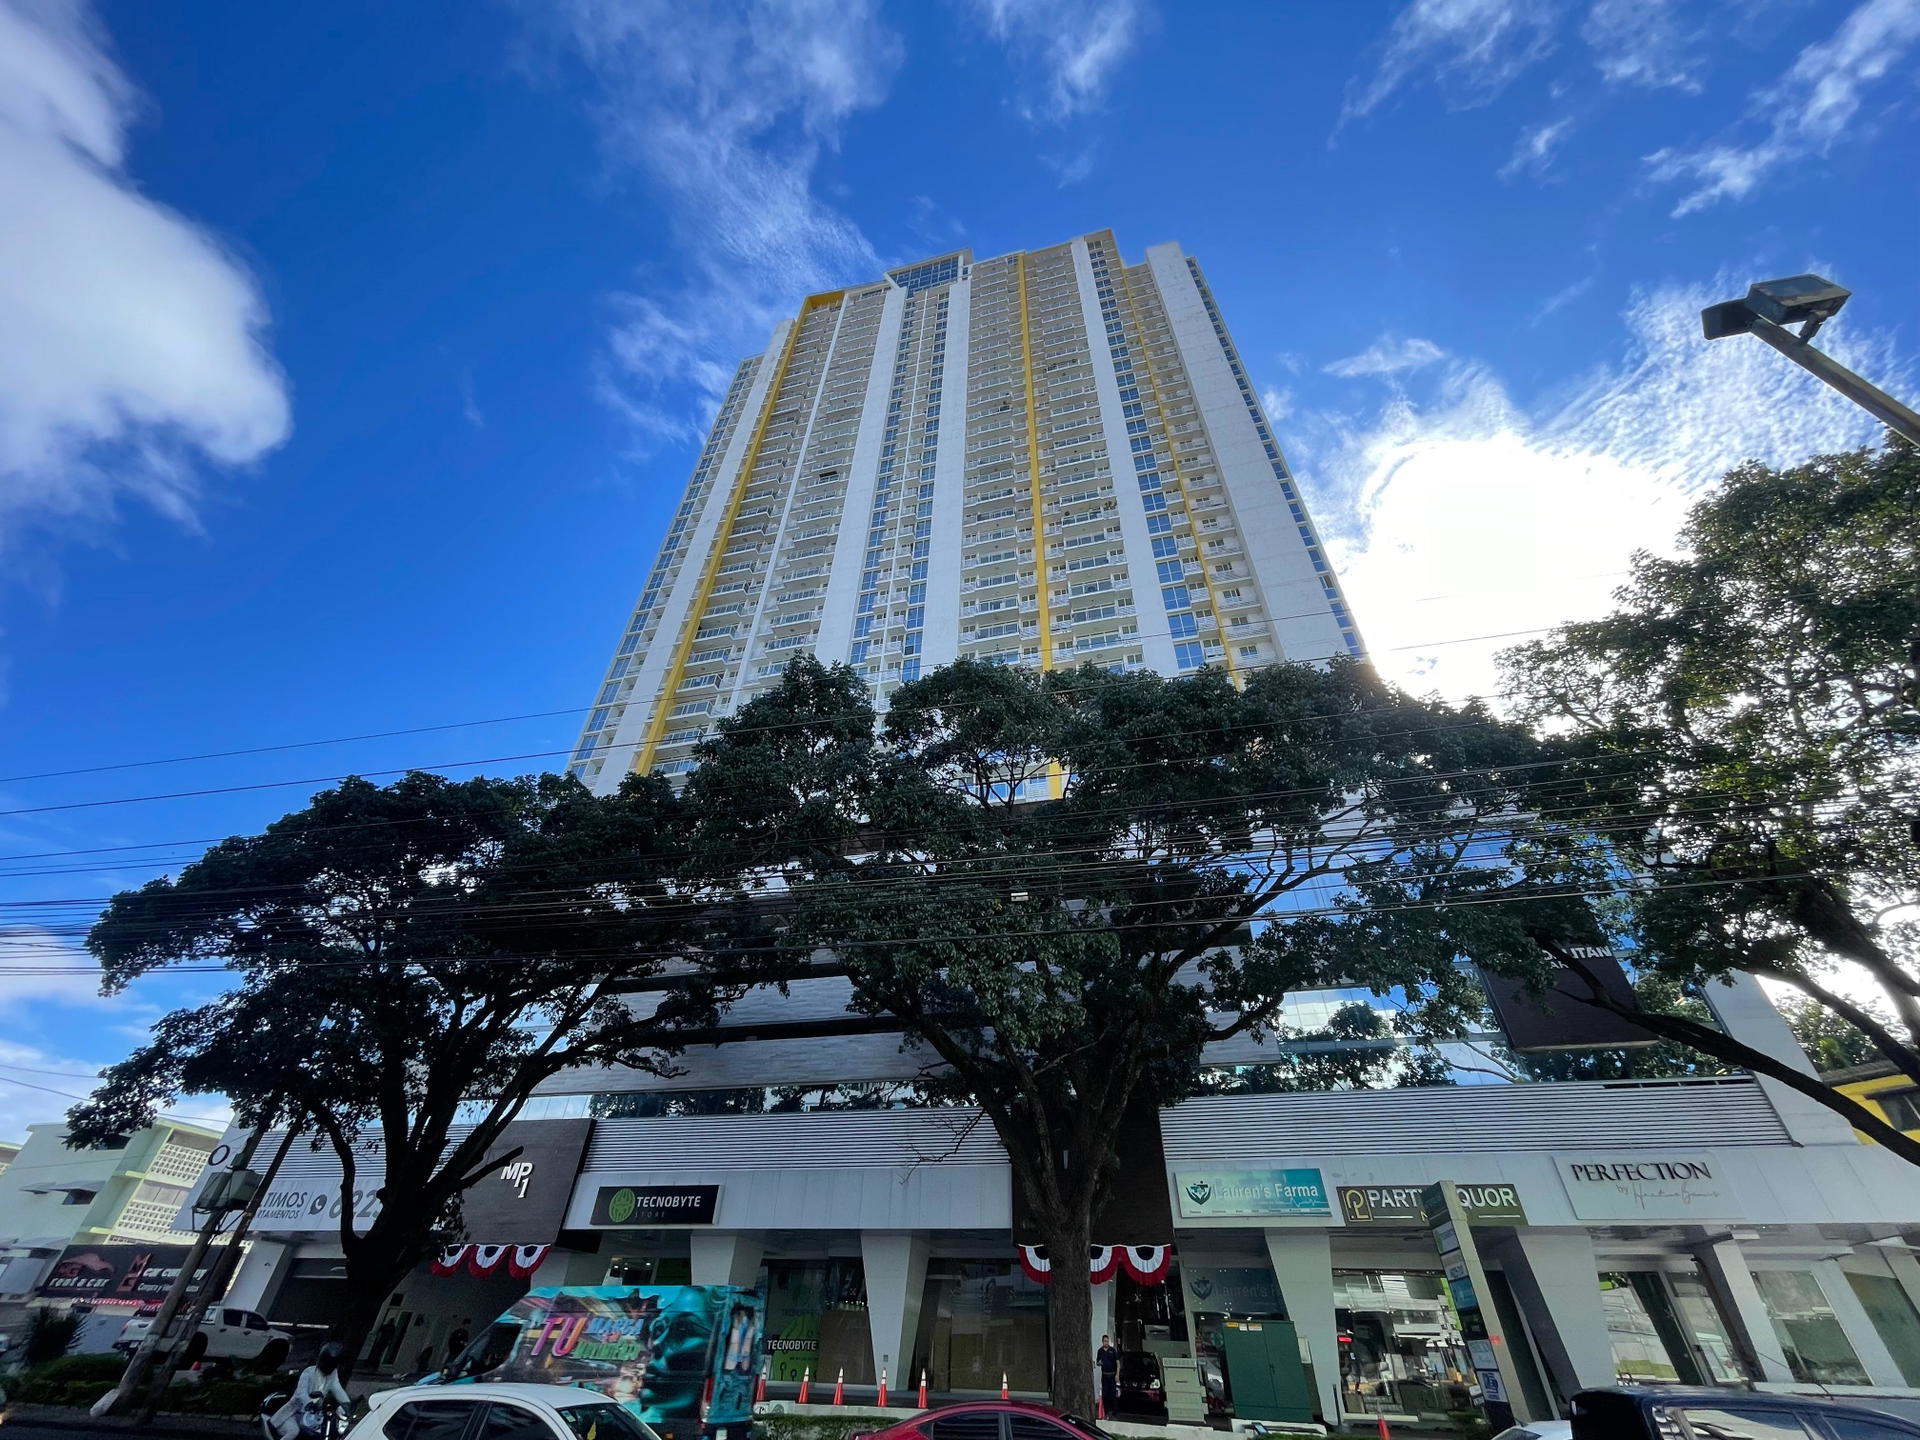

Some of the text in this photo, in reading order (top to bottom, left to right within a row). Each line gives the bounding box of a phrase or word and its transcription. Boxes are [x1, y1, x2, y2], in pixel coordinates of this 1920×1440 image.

[1570, 1162, 1713, 1182] PERFECTION
[1214, 1183, 1319, 1200] Lauren's Farma
[635, 1195, 702, 1208] TECNOBYTE
[48, 1276, 111, 1288] rent a car
[530, 1316, 588, 1357] TU
[766, 1339, 818, 1351] TECNOBYTE
